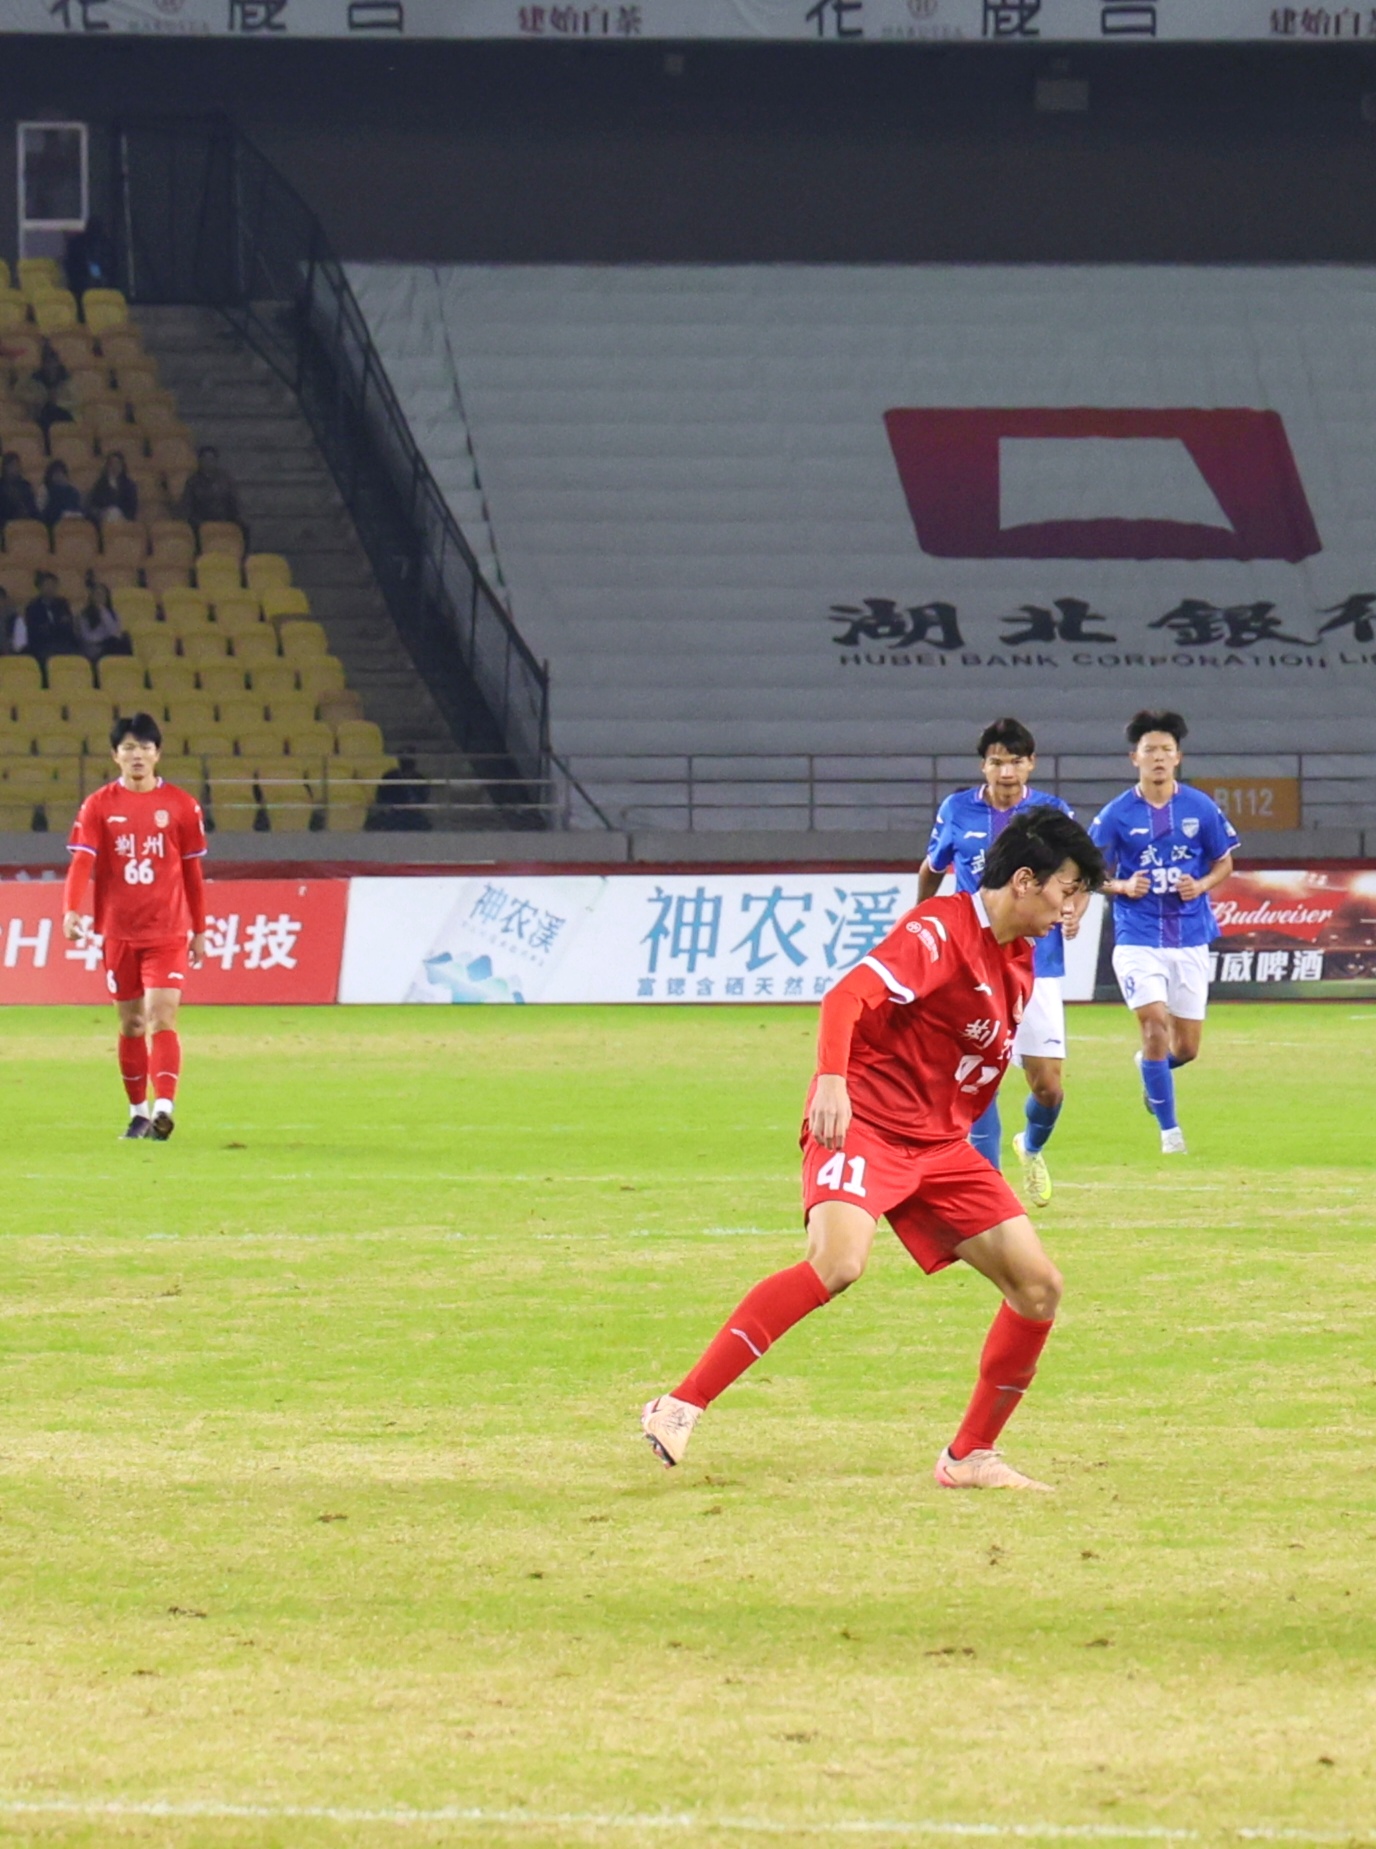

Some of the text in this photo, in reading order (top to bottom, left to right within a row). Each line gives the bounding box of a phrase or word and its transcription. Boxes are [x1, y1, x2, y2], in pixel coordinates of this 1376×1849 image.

[840, 653, 946, 667] HUBEI
[961, 653, 1058, 667] BANK
[1072, 652, 1326, 668] CORPORATION
[1139, 845, 1193, 868] 武汉
[124, 858, 154, 885] 66
[1152, 867, 1182, 895] 39
[468, 882, 567, 954] 神农溪
[1210, 899, 1333, 927] Budweiser
[65, 907, 302, 971] 华科技
[639, 886, 900, 973] 神农溪
[816, 1151, 867, 1198] 41
